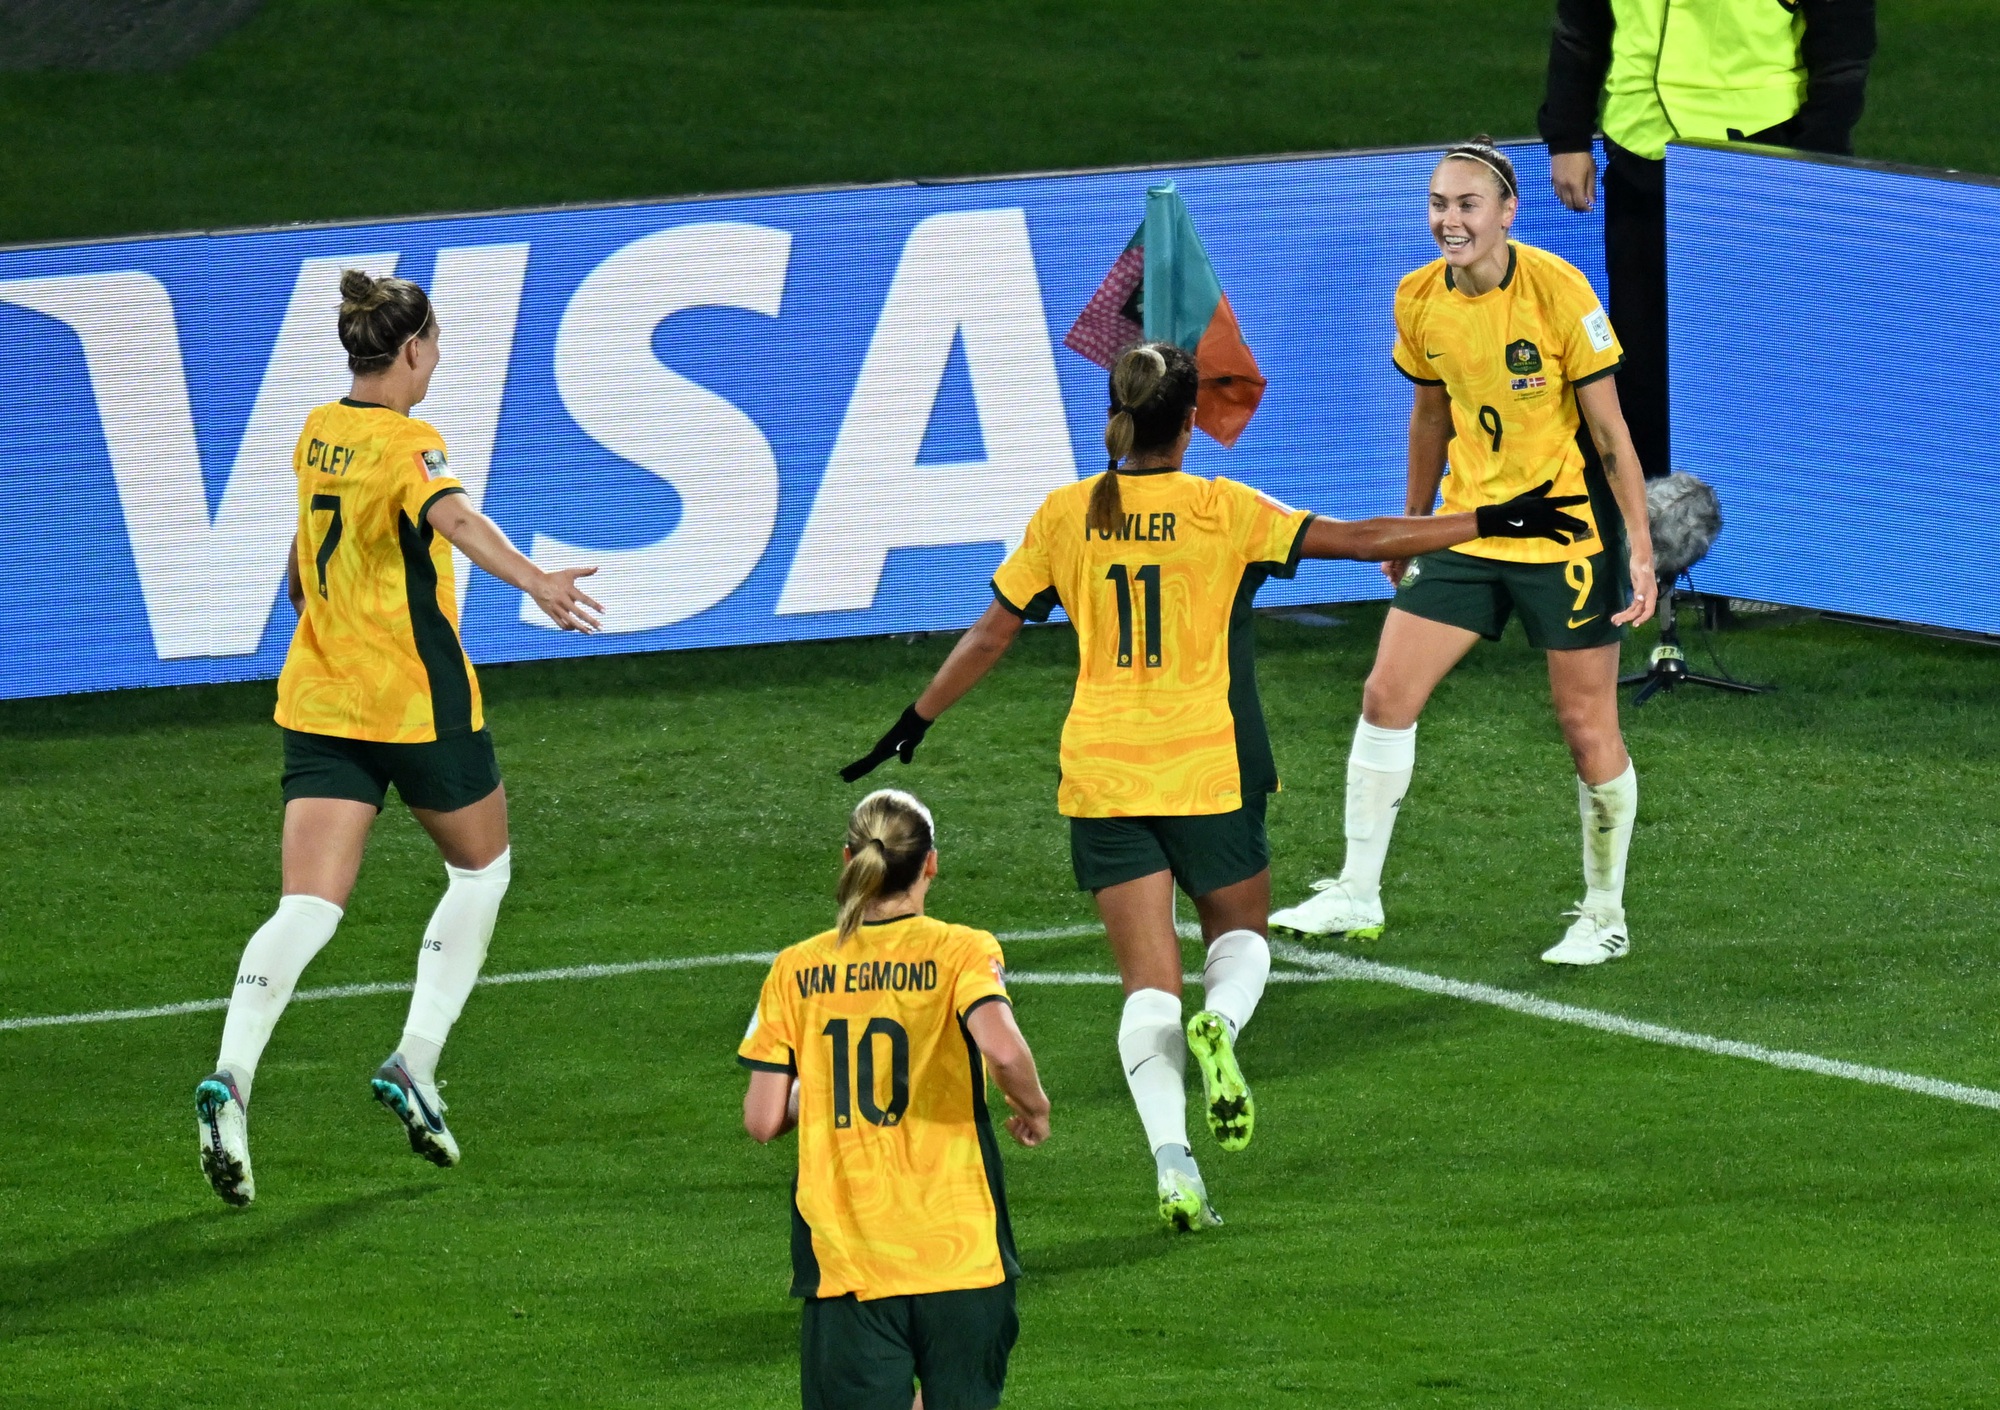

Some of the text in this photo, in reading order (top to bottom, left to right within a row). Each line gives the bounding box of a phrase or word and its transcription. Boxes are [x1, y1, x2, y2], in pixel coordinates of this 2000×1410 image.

[0, 207, 1079, 660] VISA
[1479, 405, 1503, 452] 9
[307, 437, 355, 476] CTLEY
[311, 494, 343, 602] 7
[1565, 557, 1594, 611] 9
[1105, 563, 1162, 668] 11
[423, 939, 443, 952] US
[236, 974, 269, 987] AUS
[796, 959, 937, 999] VAN EGMOND
[822, 1017, 909, 1128] 10
